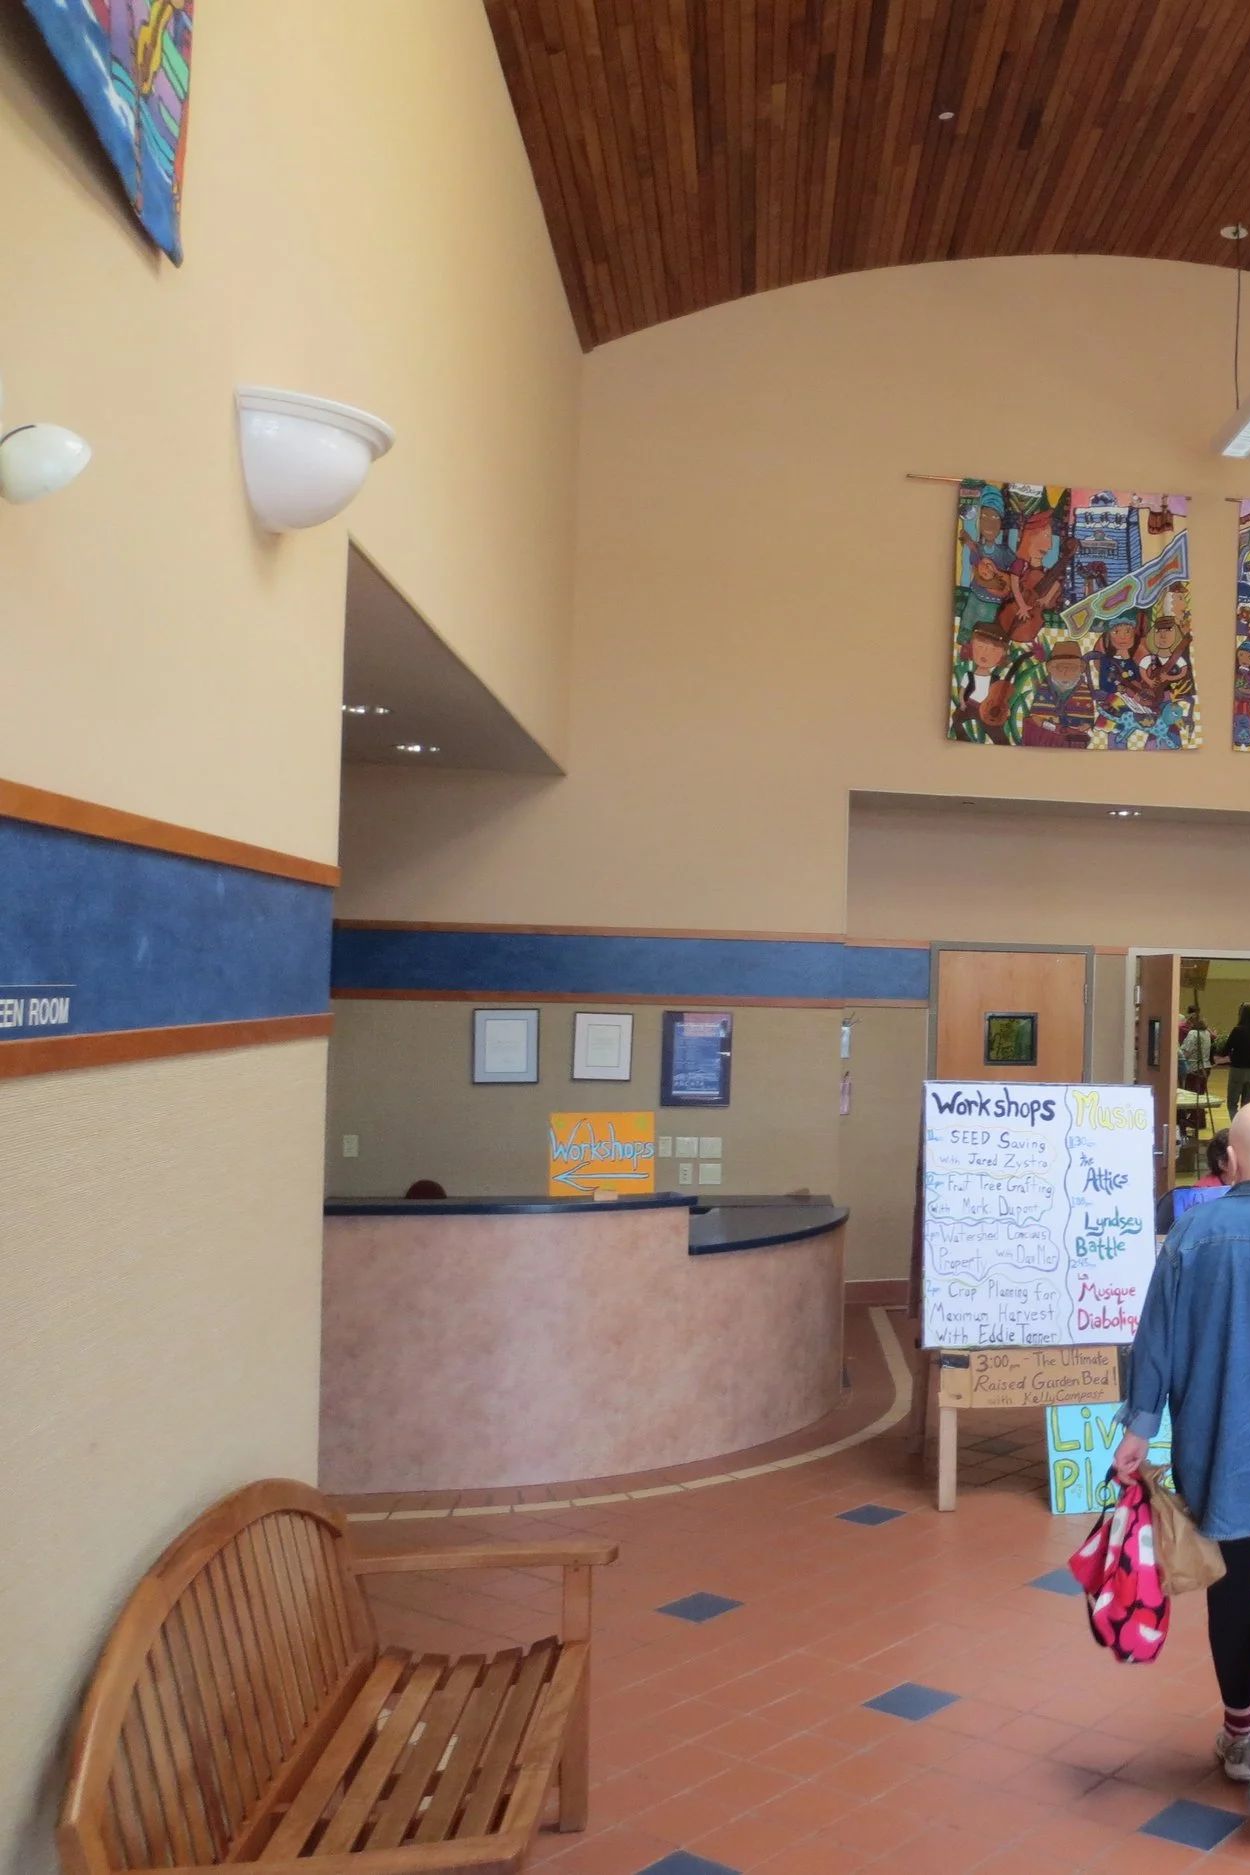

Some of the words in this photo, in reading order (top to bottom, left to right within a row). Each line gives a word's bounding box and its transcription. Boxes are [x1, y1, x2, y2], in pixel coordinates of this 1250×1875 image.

[28, 997, 70, 1026] ROOM
[931, 1087, 1056, 1127] Workshops
[1072, 1090, 1147, 1130] Music
[548, 1118, 655, 1171] Workshops
[950, 1130, 991, 1145] SEED
[998, 1131, 1046, 1153] Saving
[968, 1153, 998, 1166] Jared
[979, 1174, 1002, 1190] Tree
[1006, 1176, 1053, 1198] Grafting
[1082, 1167, 1129, 1195] Attics
[1084, 1205, 1143, 1237] Lyndsey
[1076, 1236, 1126, 1260] Battle
[948, 1282, 977, 1301] Crop
[1078, 1282, 1136, 1304] Musique
[999, 1303, 1055, 1321] Harvest
[1078, 1305, 1140, 1335] Diaboliqu
[979, 1324, 1015, 1344] Eddie
[1016, 1323, 1057, 1344] Tanner
[1033, 1350, 1056, 1367] The
[1060, 1350, 1109, 1367] Ultimate
[974, 1374, 1026, 1392] Raised
[1032, 1372, 1080, 1390] Garden
[1050, 1405, 1127, 1452] Liv
